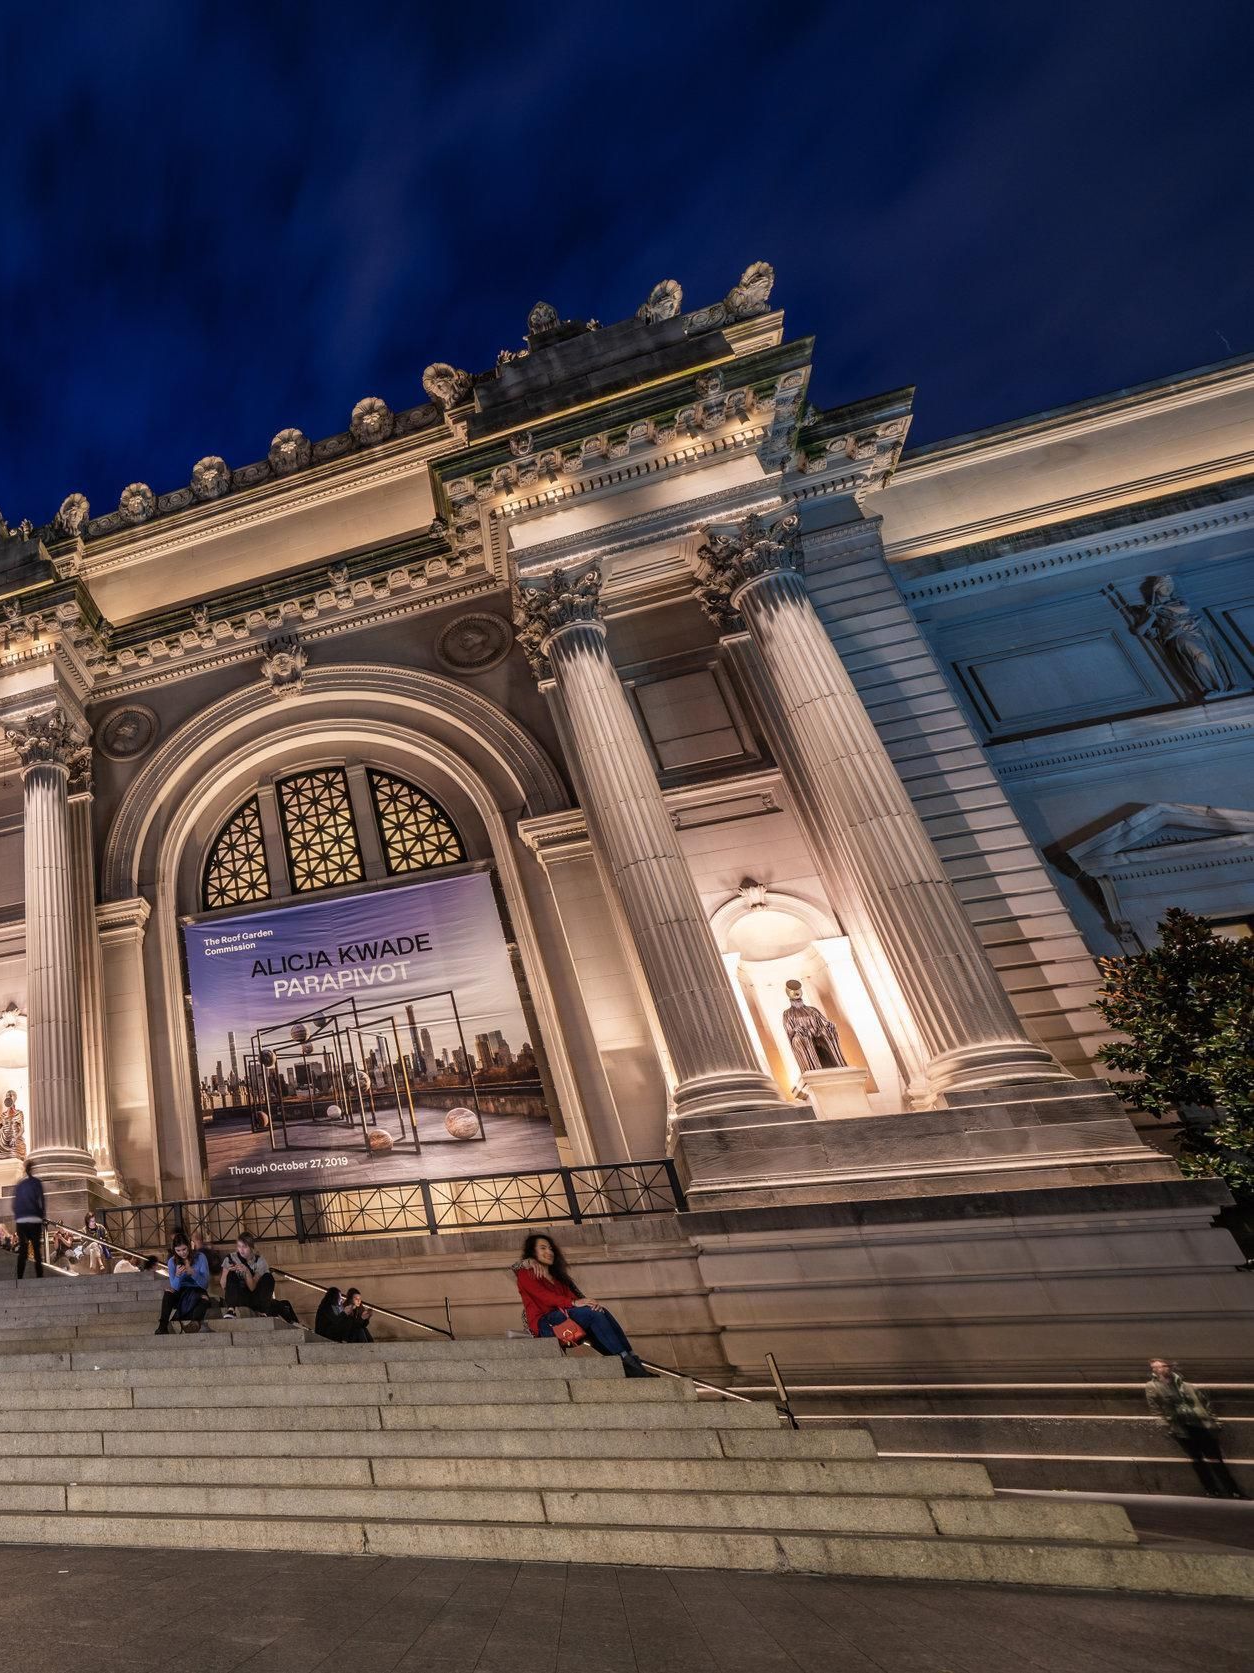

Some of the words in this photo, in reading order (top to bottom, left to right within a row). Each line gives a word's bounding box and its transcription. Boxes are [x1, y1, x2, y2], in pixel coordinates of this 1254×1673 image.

[203, 938, 220, 946] The
[221, 933, 241, 944] Roof
[242, 929, 274, 940] Garden
[205, 943, 256, 956] Commission
[251, 950, 333, 978] ALICJA
[337, 933, 433, 965] KWADE
[273, 960, 411, 999] PARAPIVOT
[228, 1164, 268, 1176] Through
[269, 1160, 308, 1172] October
[309, 1158, 324, 1169] 27,
[324, 1156, 349, 1168] 2019
